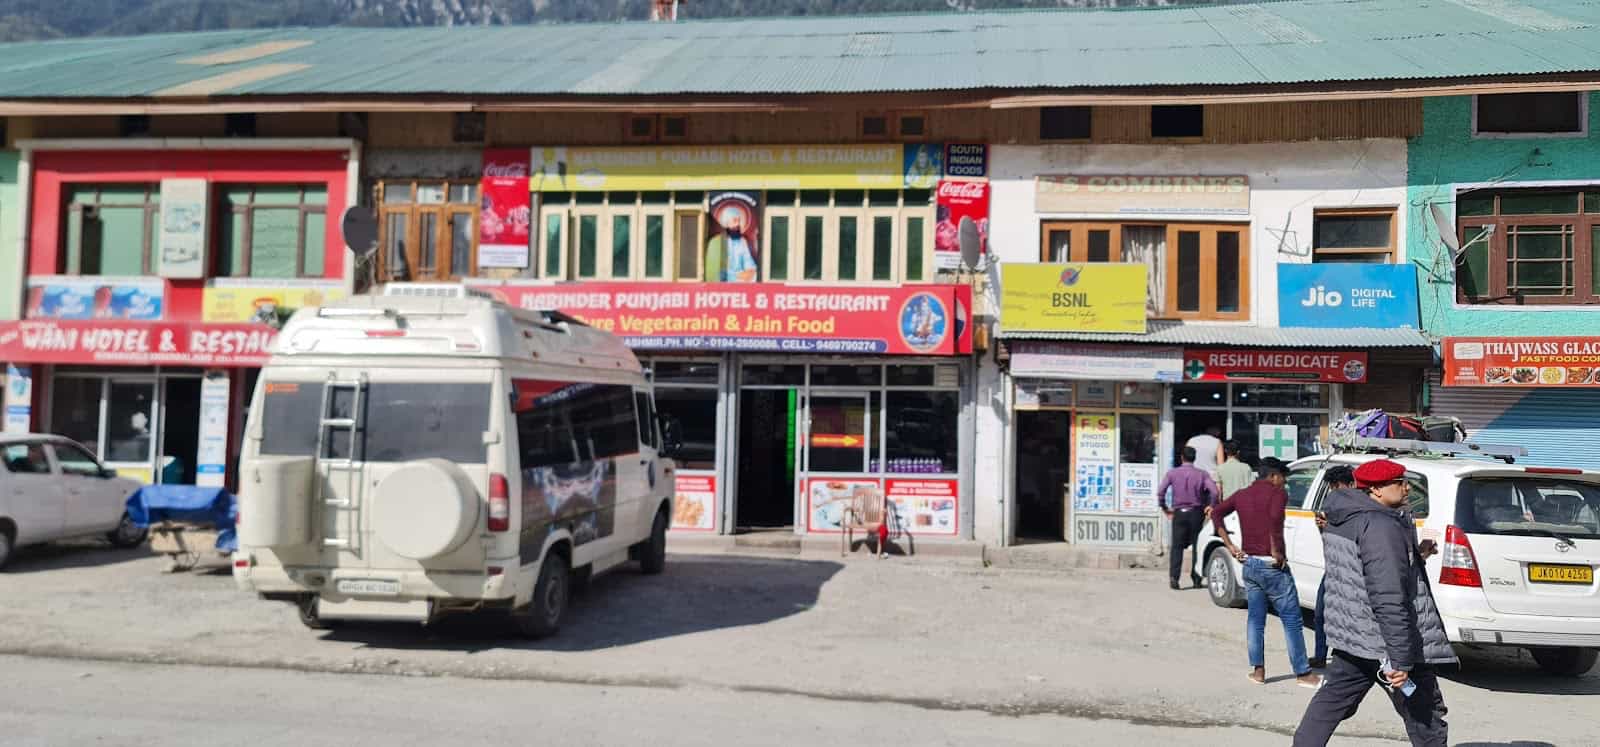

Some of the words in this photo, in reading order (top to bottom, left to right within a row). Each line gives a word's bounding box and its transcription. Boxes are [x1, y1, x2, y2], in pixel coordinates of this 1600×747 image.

[951, 144, 983, 153] SOUTH
[729, 150, 776, 164] HOTEL
[797, 149, 896, 163] RESTAURANT
[950, 155, 982, 164] INDIAN
[949, 166, 982, 175] FOODS
[1088, 176, 1244, 192] COMBINES
[520, 293, 611, 311] NARINDER
[615, 292, 689, 311] PUNJABI
[695, 292, 750, 308] HOTEL
[755, 293, 768, 309] &
[774, 293, 890, 312] RESTAURANT
[1052, 293, 1091, 307] BSNL
[1301, 285, 1342, 307] Jio
[1351, 288, 1396, 298] DIGITAL
[1351, 299, 1376, 308] LIFE
[620, 315, 719, 335] Vegetarain
[724, 314, 741, 331] &
[745, 315, 781, 332] Jain
[788, 316, 835, 333] Food
[81, 329, 149, 351] HOTEL
[158, 328, 176, 351] &
[1485, 342, 1558, 361] THAJWASS
[1209, 354, 1252, 367] RESHI
[1258, 355, 1339, 368] MEDICATE
[1082, 433, 1108, 441] PHOTO
[1080, 441, 1110, 449] STUDIO
[1136, 480, 1152, 488] SBI
[1078, 520, 1099, 541] STD
[1105, 520, 1125, 541] ISD
